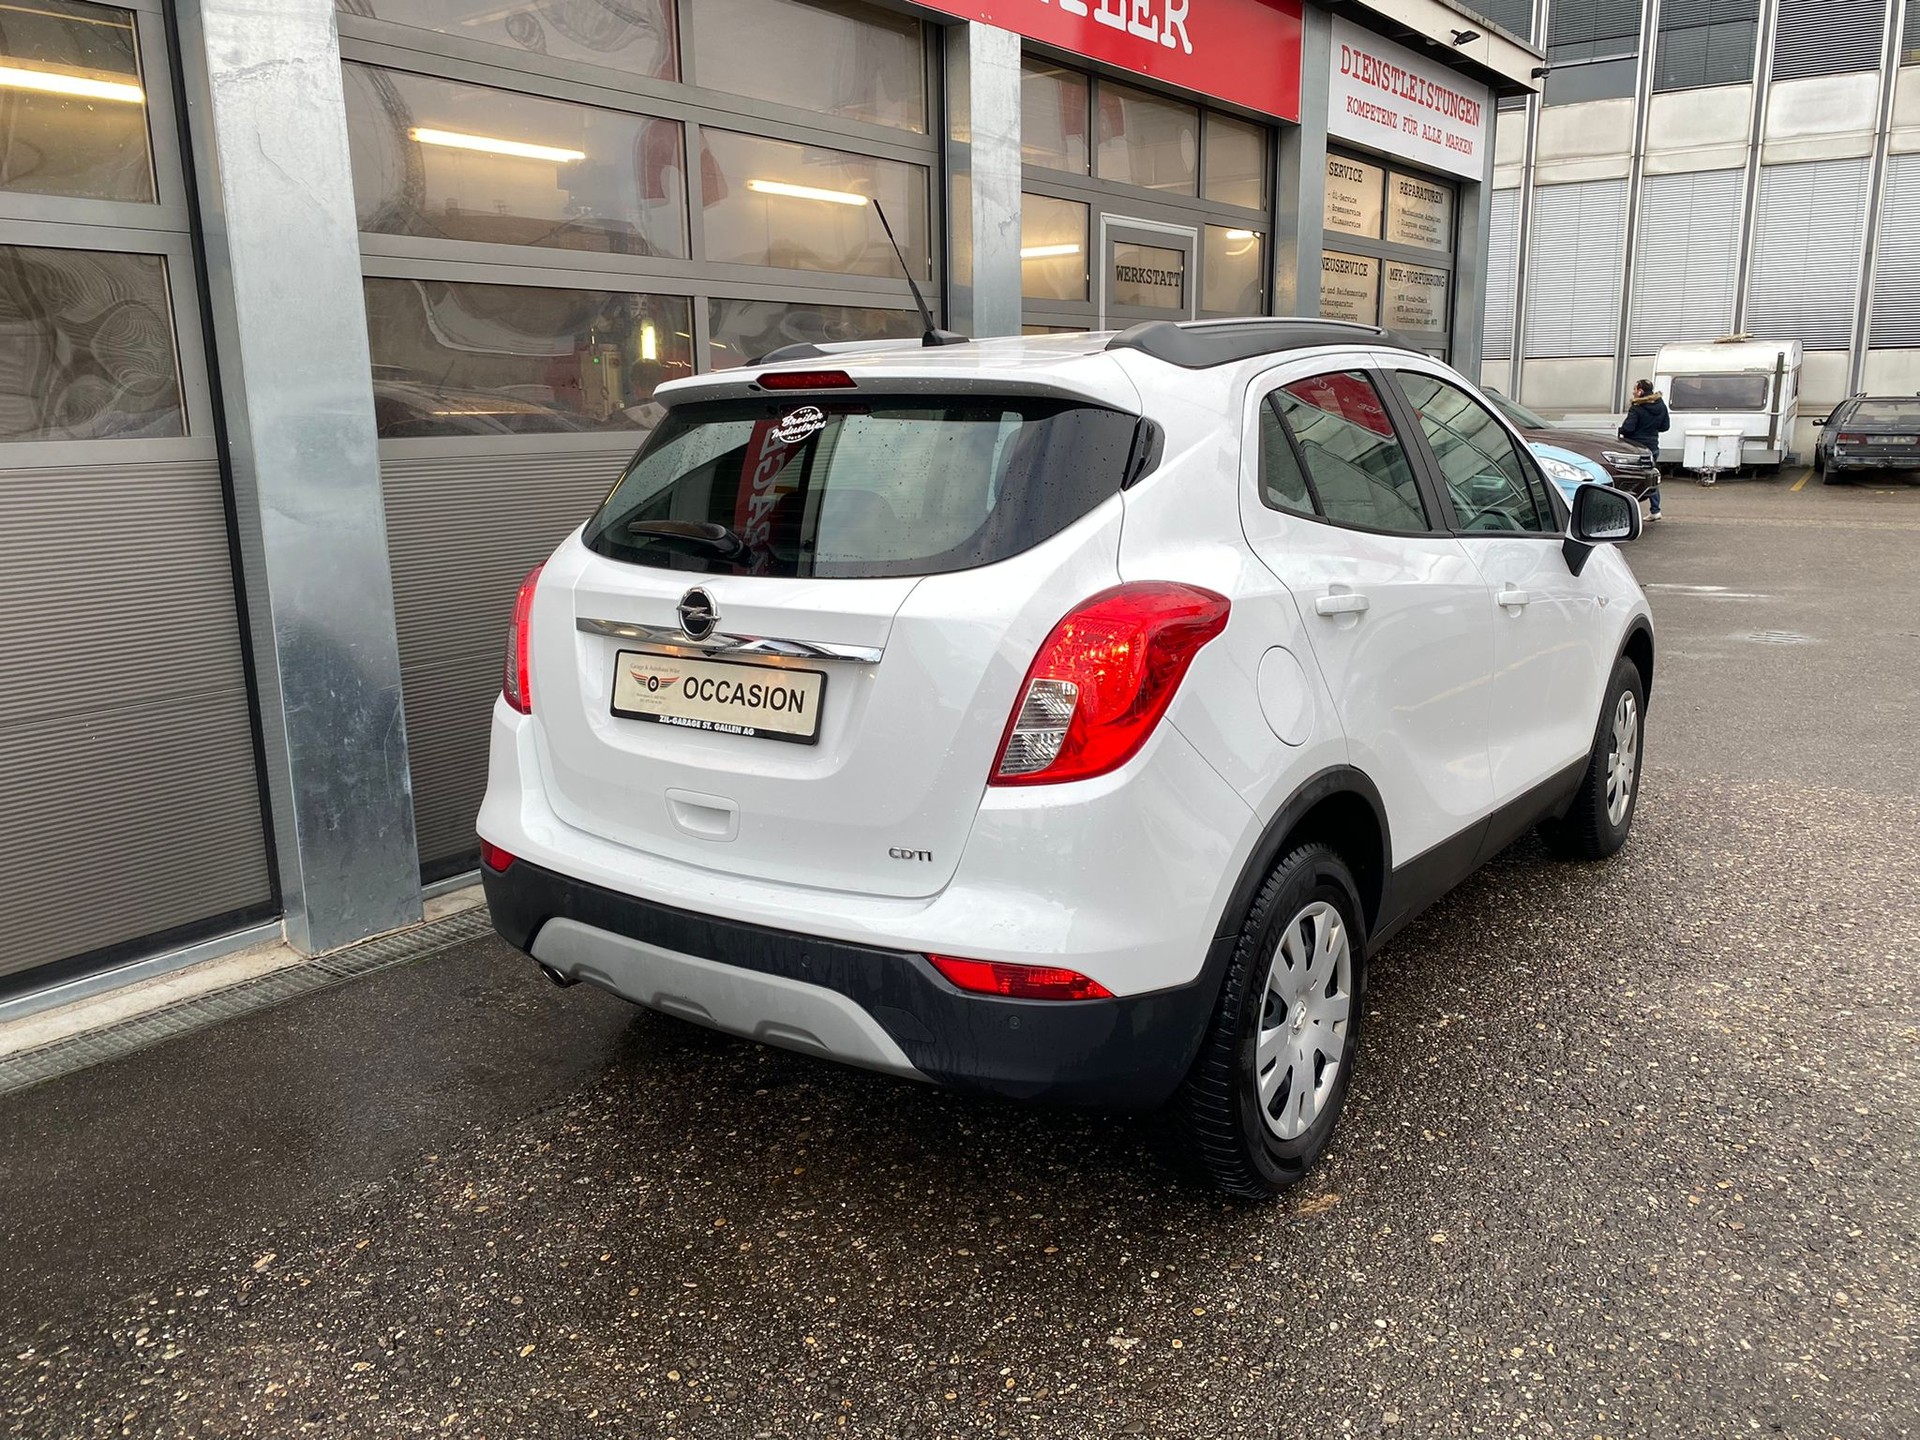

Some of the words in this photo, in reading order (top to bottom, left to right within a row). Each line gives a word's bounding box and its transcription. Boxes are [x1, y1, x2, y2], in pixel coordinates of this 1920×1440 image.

[1340, 44, 1480, 127] DIENSTLEISTUNGEN
[1346, 95, 1398, 129] KOMPETENZ
[1402, 114, 1418, 137] FÜR
[1422, 125, 1442, 145] ALLE
[1445, 133, 1473, 155] MARKEN
[1328, 161, 1364, 183] SERVICE
[1399, 181, 1443, 204] REPARATUREN
[1115, 264, 1181, 288] WERKSTATT
[1321, 257, 1369, 277] NEUSERVICE
[771, 420, 827, 440] Industries
[682, 676, 805, 714] OCCASION
[659, 715, 701, 728] ZIL-GARAGE
[702, 721, 712, 730] ST.
[714, 723, 742, 734] GALLEN
[743, 727, 755, 736] AG
[888, 846, 932, 862] CDTI
